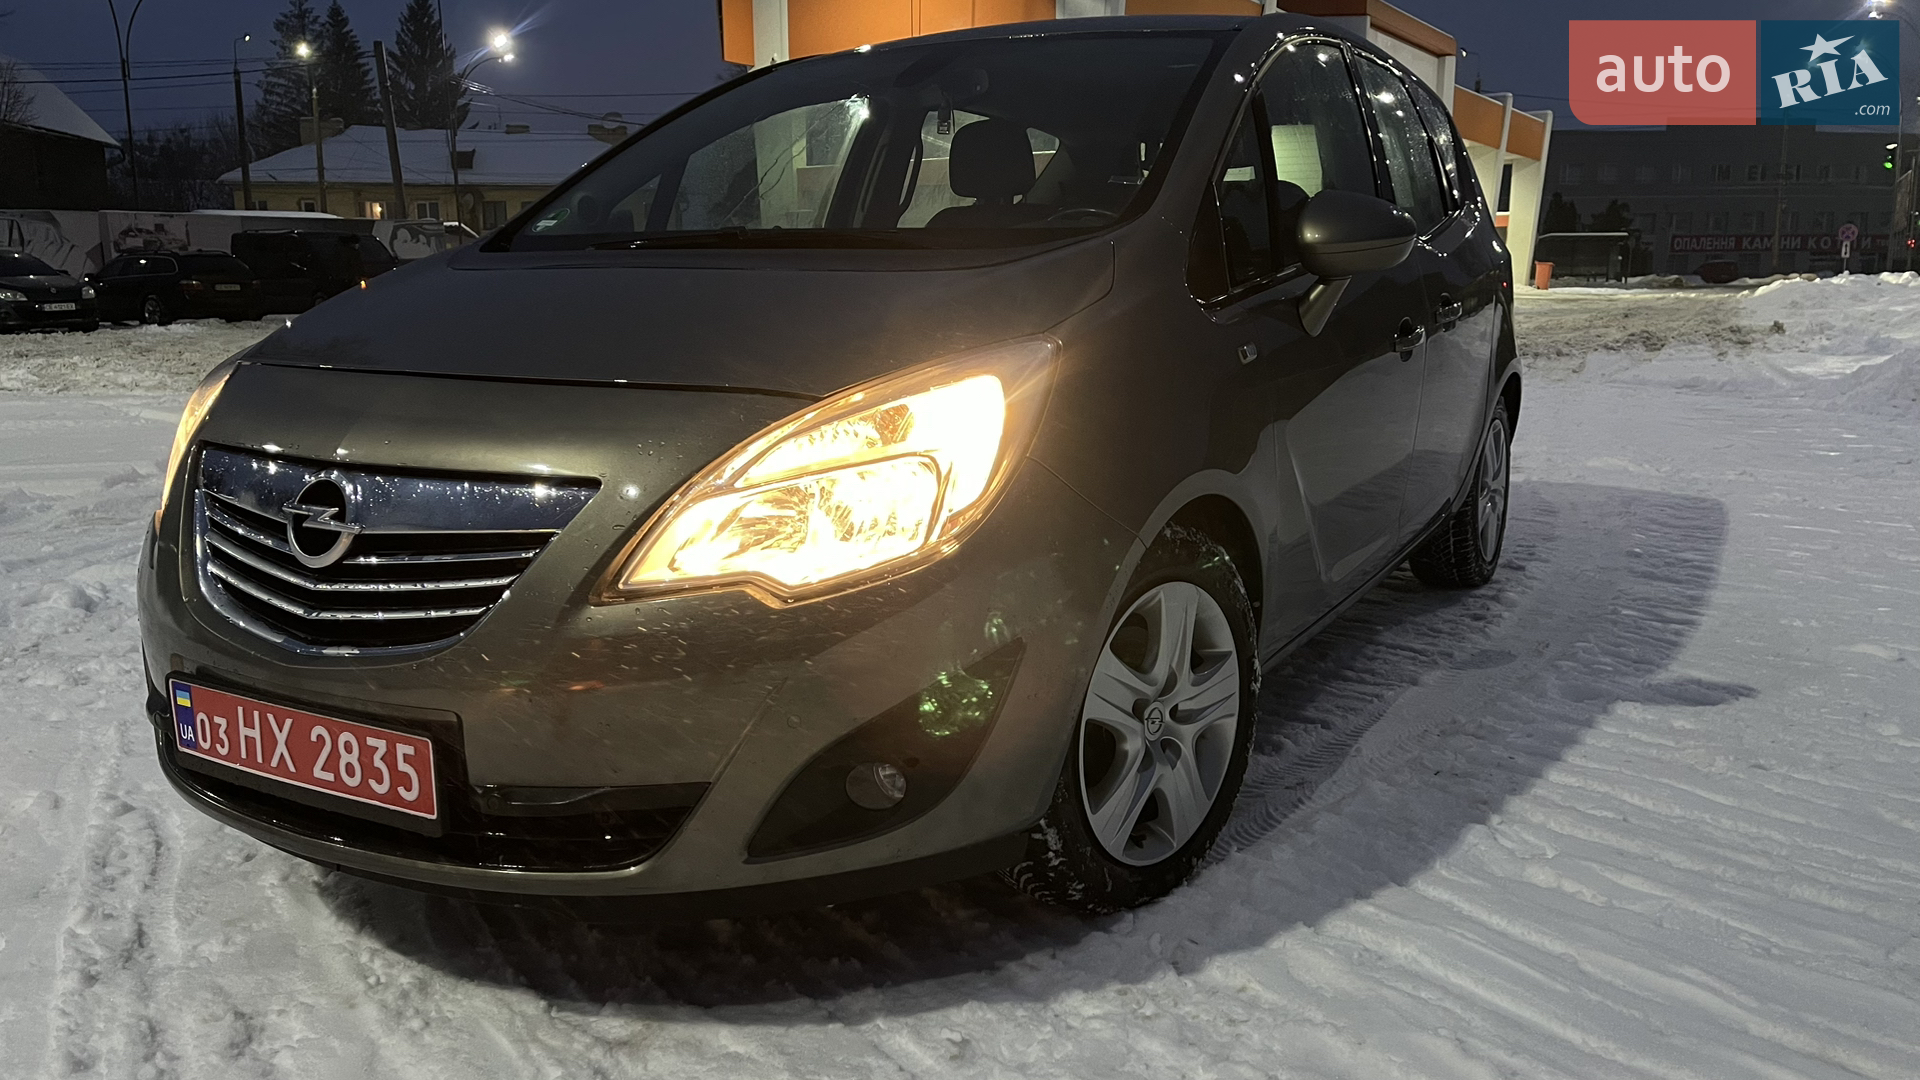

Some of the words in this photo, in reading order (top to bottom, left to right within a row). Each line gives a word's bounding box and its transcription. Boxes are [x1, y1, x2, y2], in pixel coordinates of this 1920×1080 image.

[1674, 236, 1736, 250] ОПАЛЕННЯ
[1741, 236, 1802, 249] КАМНИ
[180, 722, 195, 742] UA
[196, 711, 230, 756] 03
[237, 705, 297, 773] HX
[310, 725, 420, 802] 2835
